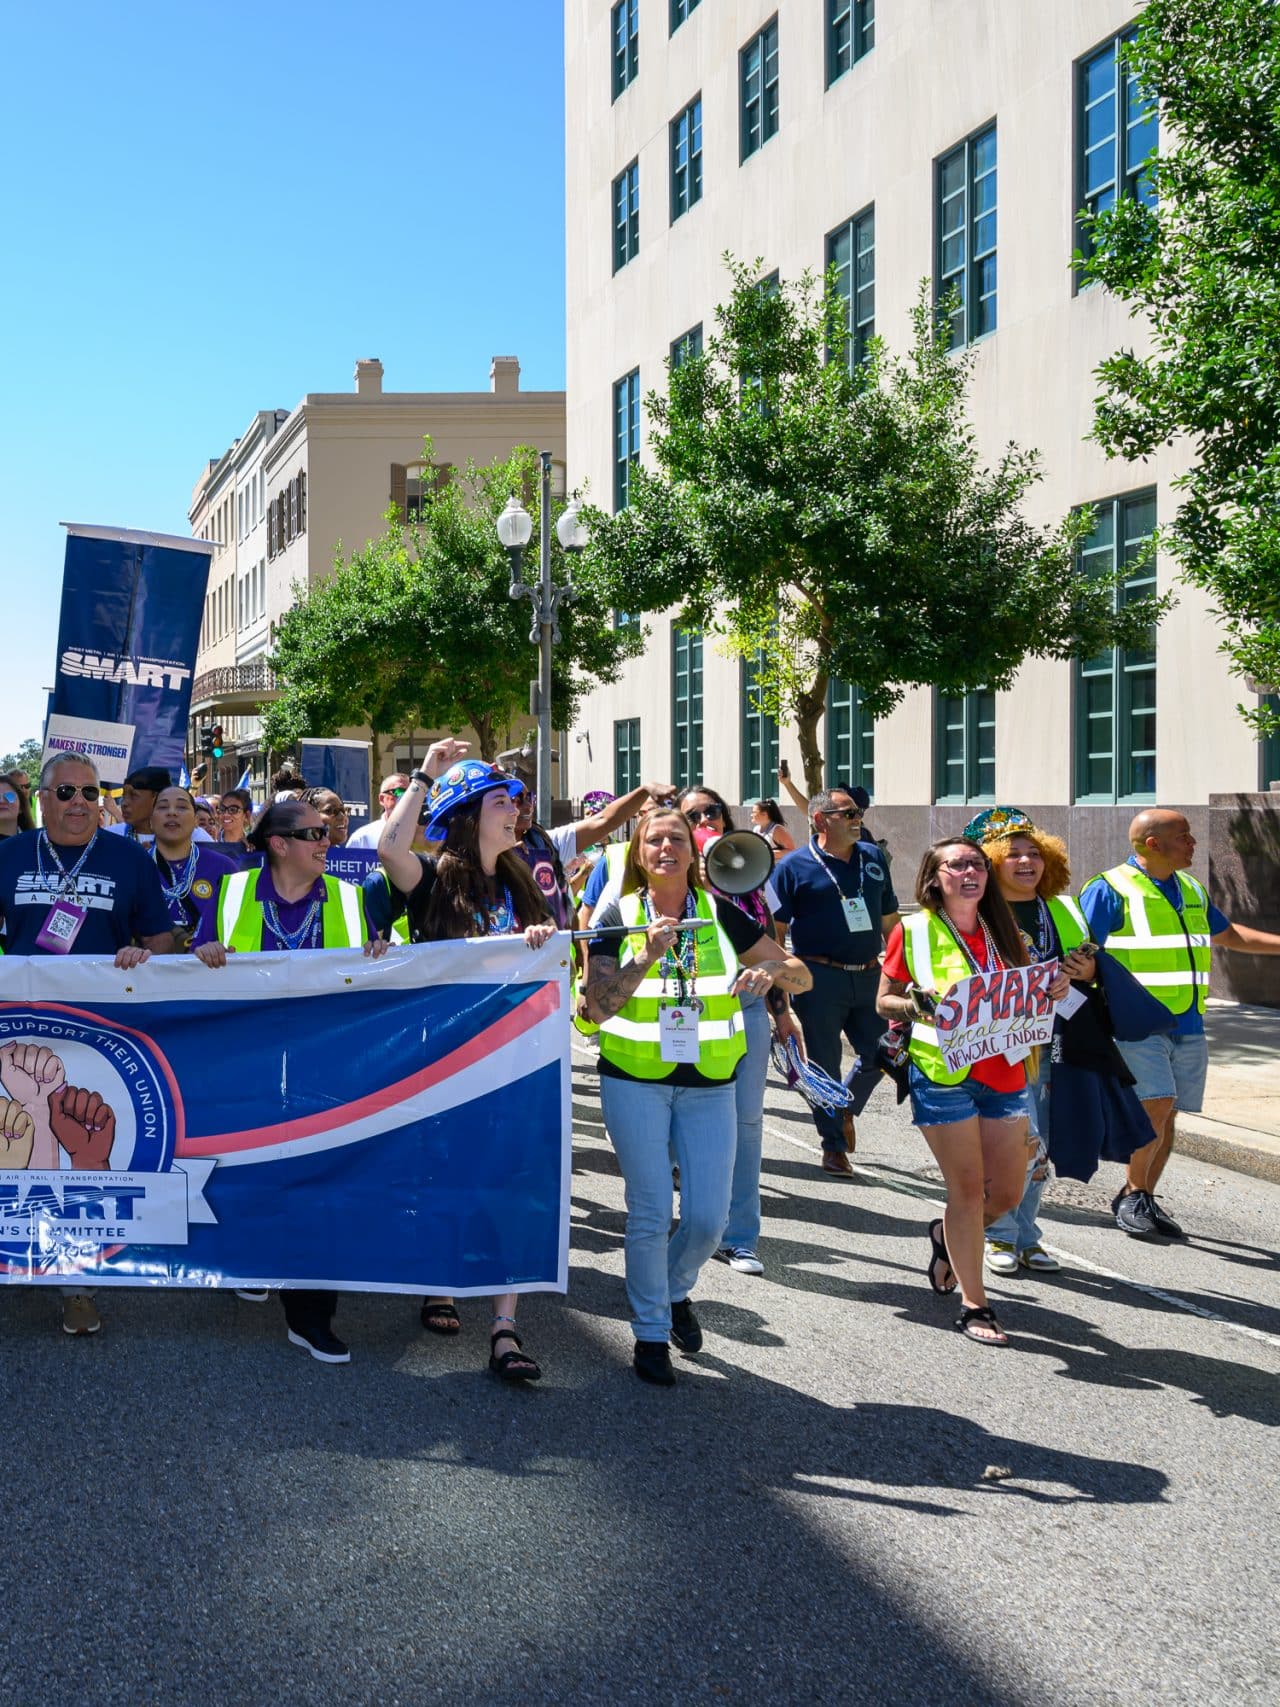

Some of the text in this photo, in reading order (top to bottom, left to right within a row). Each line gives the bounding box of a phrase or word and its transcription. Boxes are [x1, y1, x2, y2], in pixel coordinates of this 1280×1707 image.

[60, 651, 190, 690] SMART
[48, 737, 127, 759] MAKES US STRONGER
[0, 1021, 88, 1038] SUPPORT
[95, 1035, 138, 1075] THEIR
[135, 1080, 156, 1138] UNION
[26, 1226, 126, 1237] CMMITTEE
